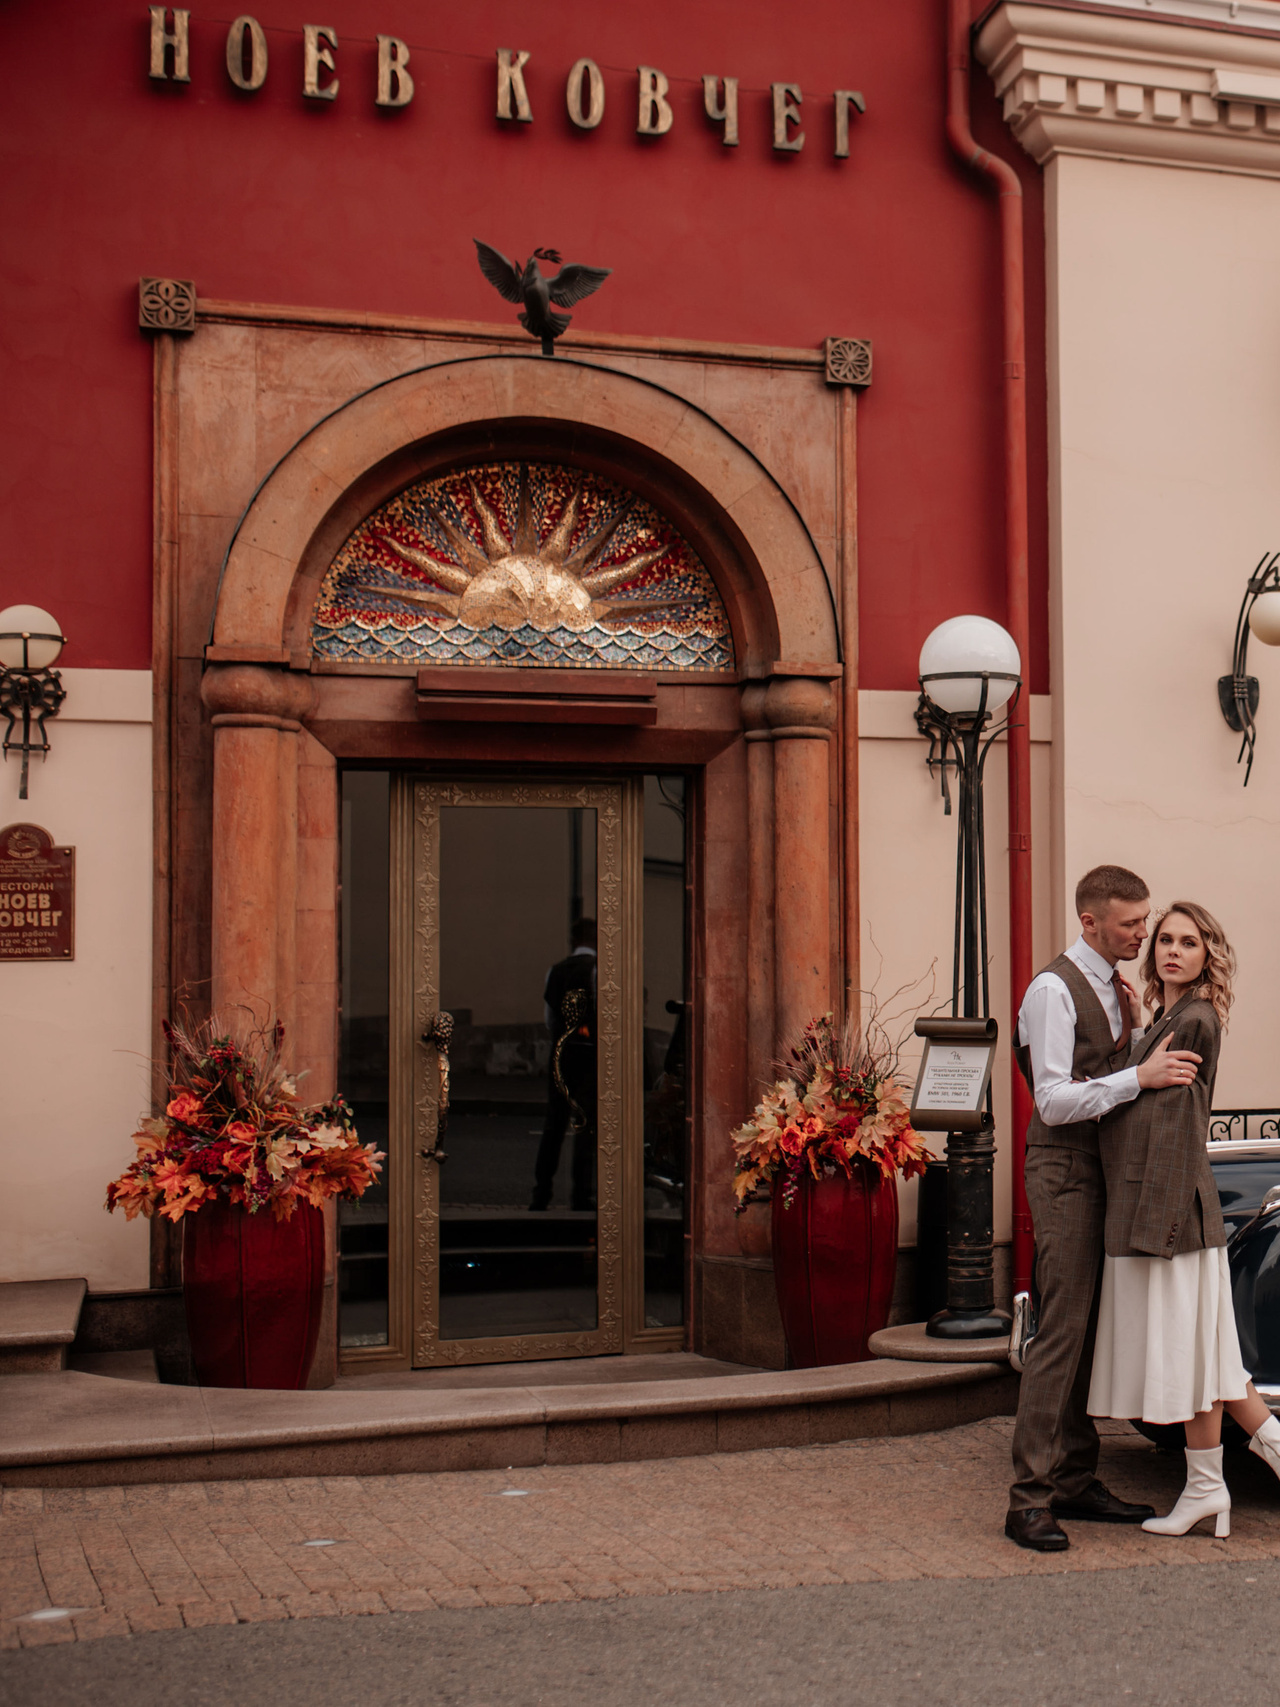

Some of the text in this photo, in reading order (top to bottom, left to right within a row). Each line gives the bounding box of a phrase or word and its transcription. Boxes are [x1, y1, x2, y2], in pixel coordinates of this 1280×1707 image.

[148, 5, 866, 159] НОЕВ КОВЧЕГ
[0, 882, 54, 891] ЕСТОРАН
[0, 893, 51, 909] НОЕВ
[0, 911, 63, 927] ОВЧЕГ
[0, 947, 52, 955] жедневно
